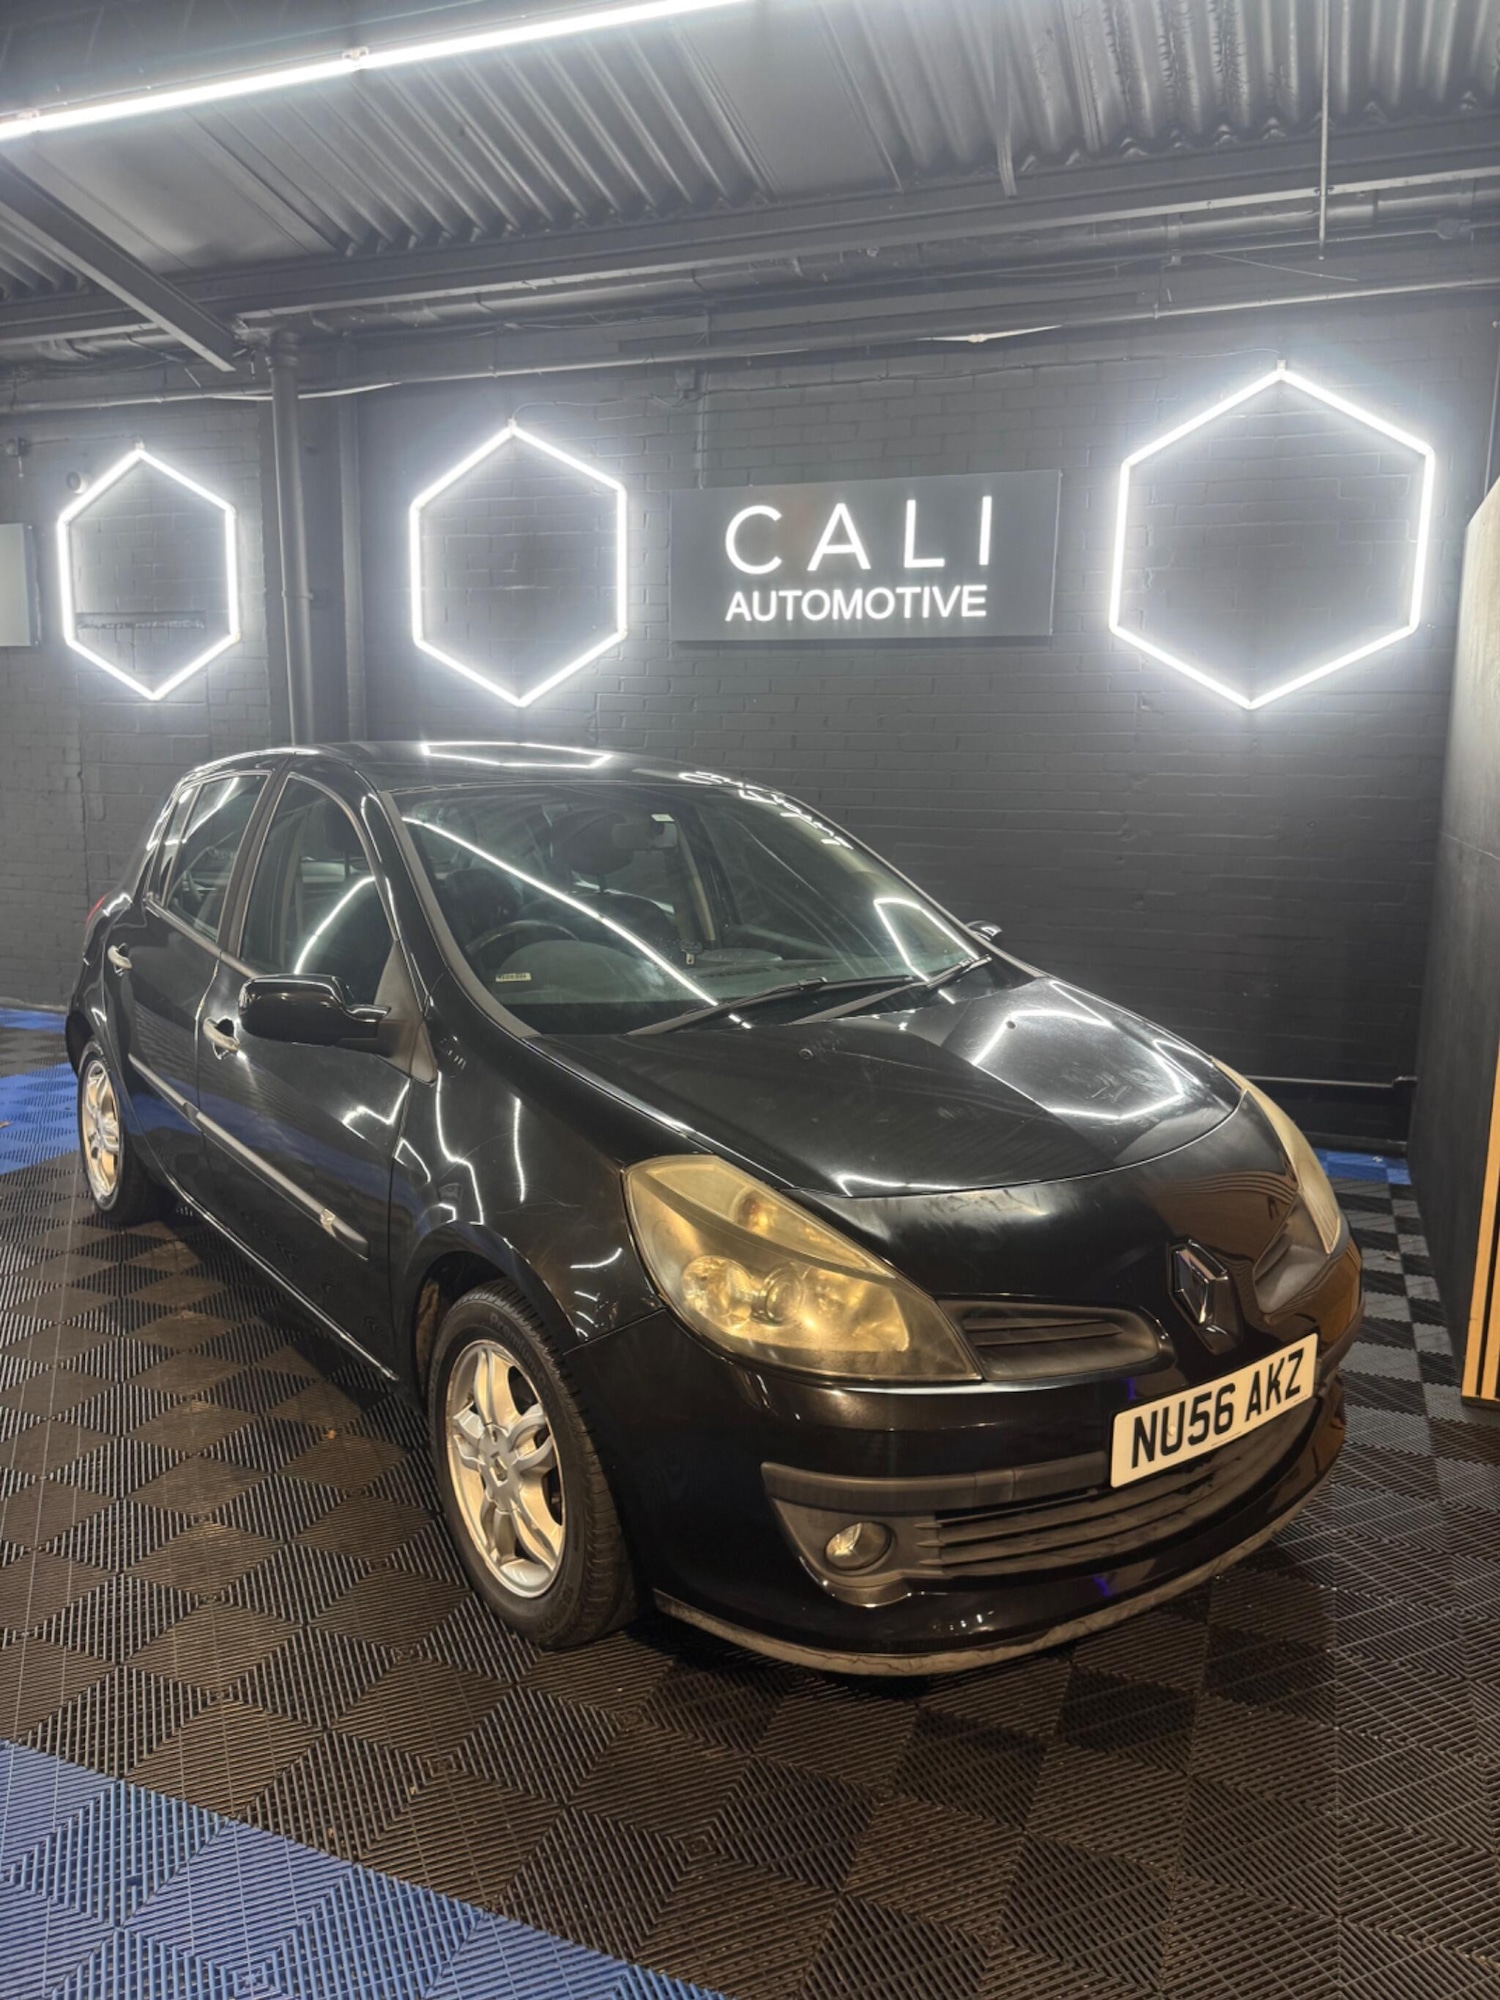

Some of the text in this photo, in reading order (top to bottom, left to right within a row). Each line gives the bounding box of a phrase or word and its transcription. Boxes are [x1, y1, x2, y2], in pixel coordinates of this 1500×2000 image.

[724, 495, 993, 575] CALI
[725, 585, 988, 622] AUTOMOTIVE
[1131, 1347, 1305, 1470] NU56 AKZ
